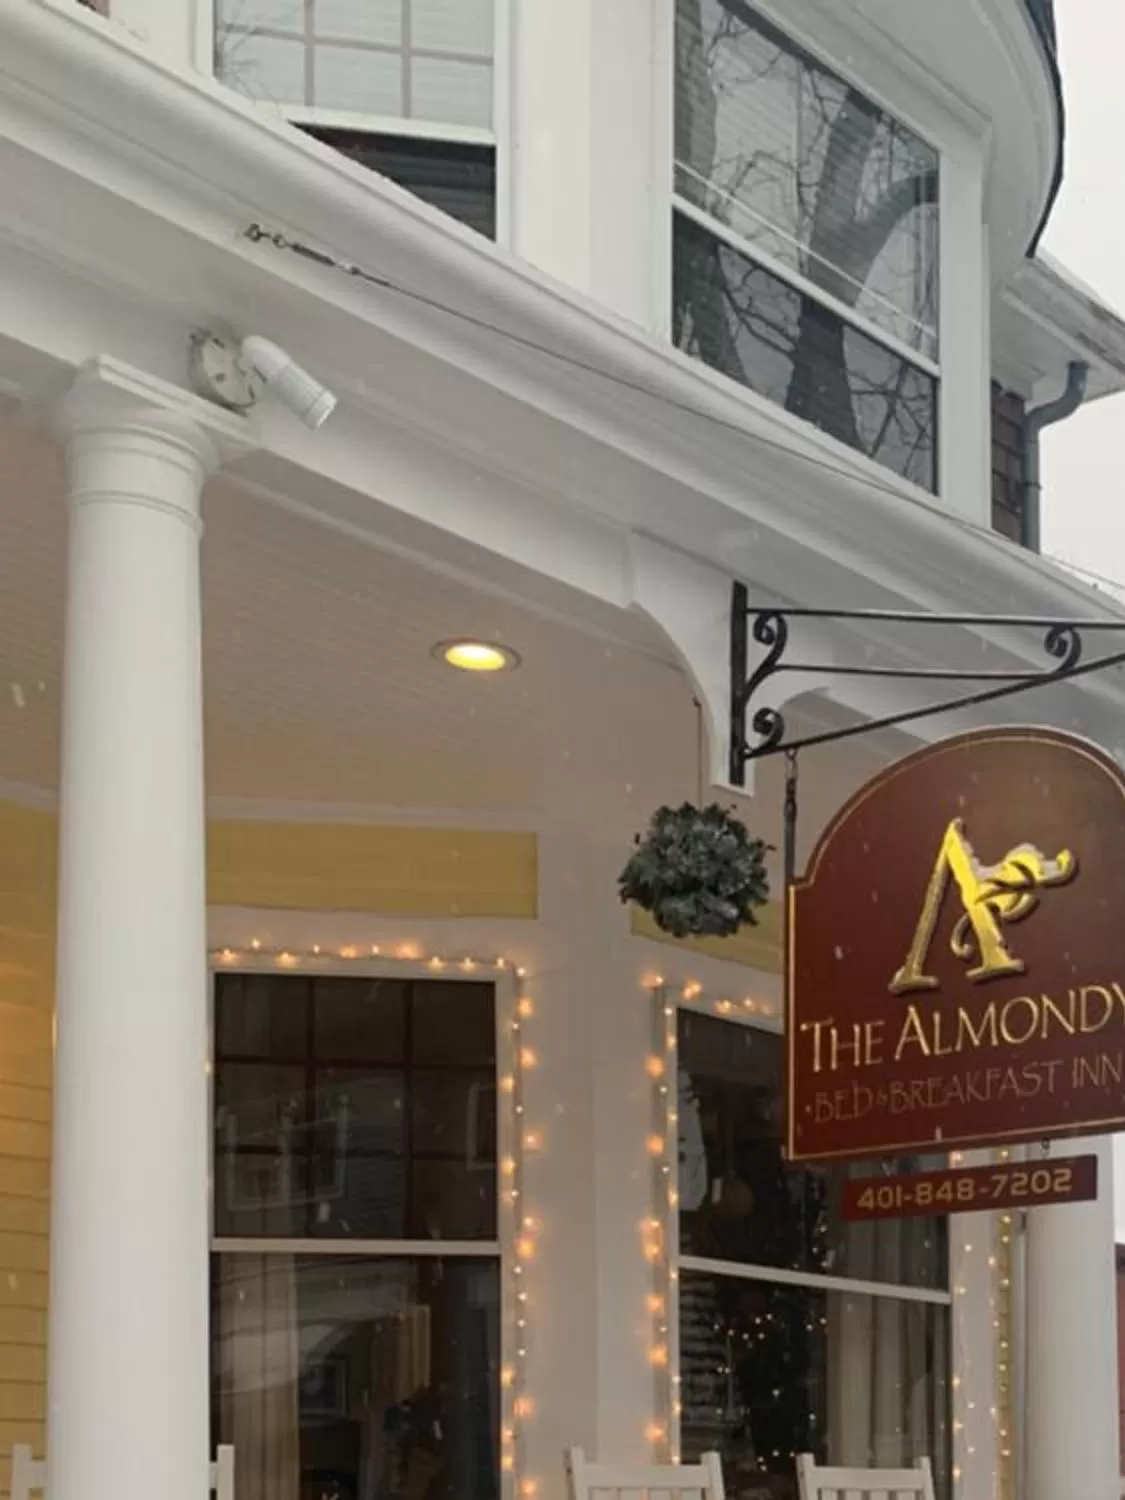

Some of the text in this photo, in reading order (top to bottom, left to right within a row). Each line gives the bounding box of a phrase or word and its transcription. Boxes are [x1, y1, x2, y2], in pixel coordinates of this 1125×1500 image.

[800, 1017, 885, 1072] THE
[815, 1080, 872, 1122] BED
[889, 1061, 1064, 1114] BREAKFAST
[1072, 1053, 1123, 1088] INN
[857, 1168, 1073, 1210] 401-848-7202
